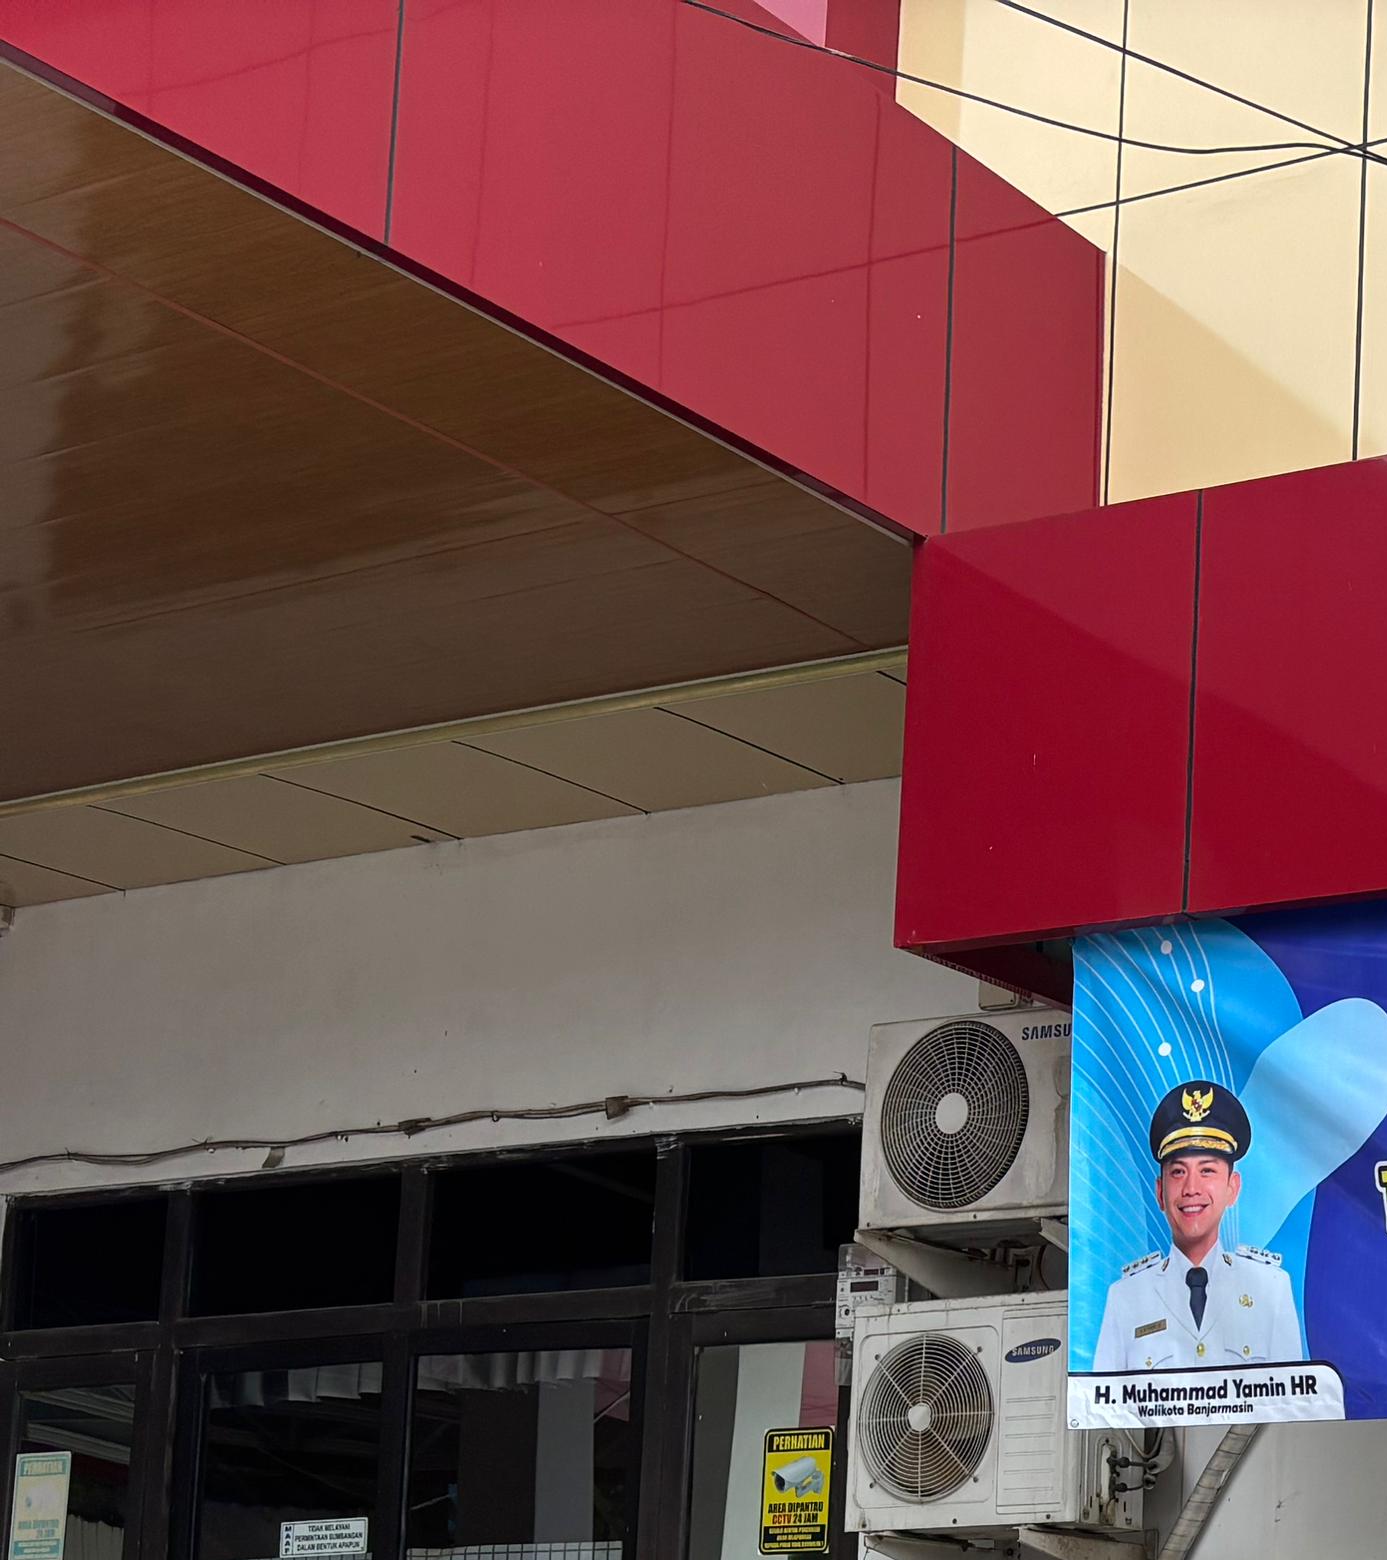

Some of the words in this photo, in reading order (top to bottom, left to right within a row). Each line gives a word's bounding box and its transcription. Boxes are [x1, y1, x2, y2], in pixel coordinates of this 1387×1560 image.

[1012, 1344, 1055, 1357] SAMSUNG
[1095, 1385, 1117, 1405] H.
[1123, 1379, 1229, 1403] Muhammad
[1232, 1376, 1286, 1399] Yamin
[1290, 1375, 1318, 1396] HR
[1138, 1403, 1185, 1418] Walikota
[1187, 1401, 1254, 1417] Banjarmasin
[773, 1434, 825, 1451] PERHATIAN
